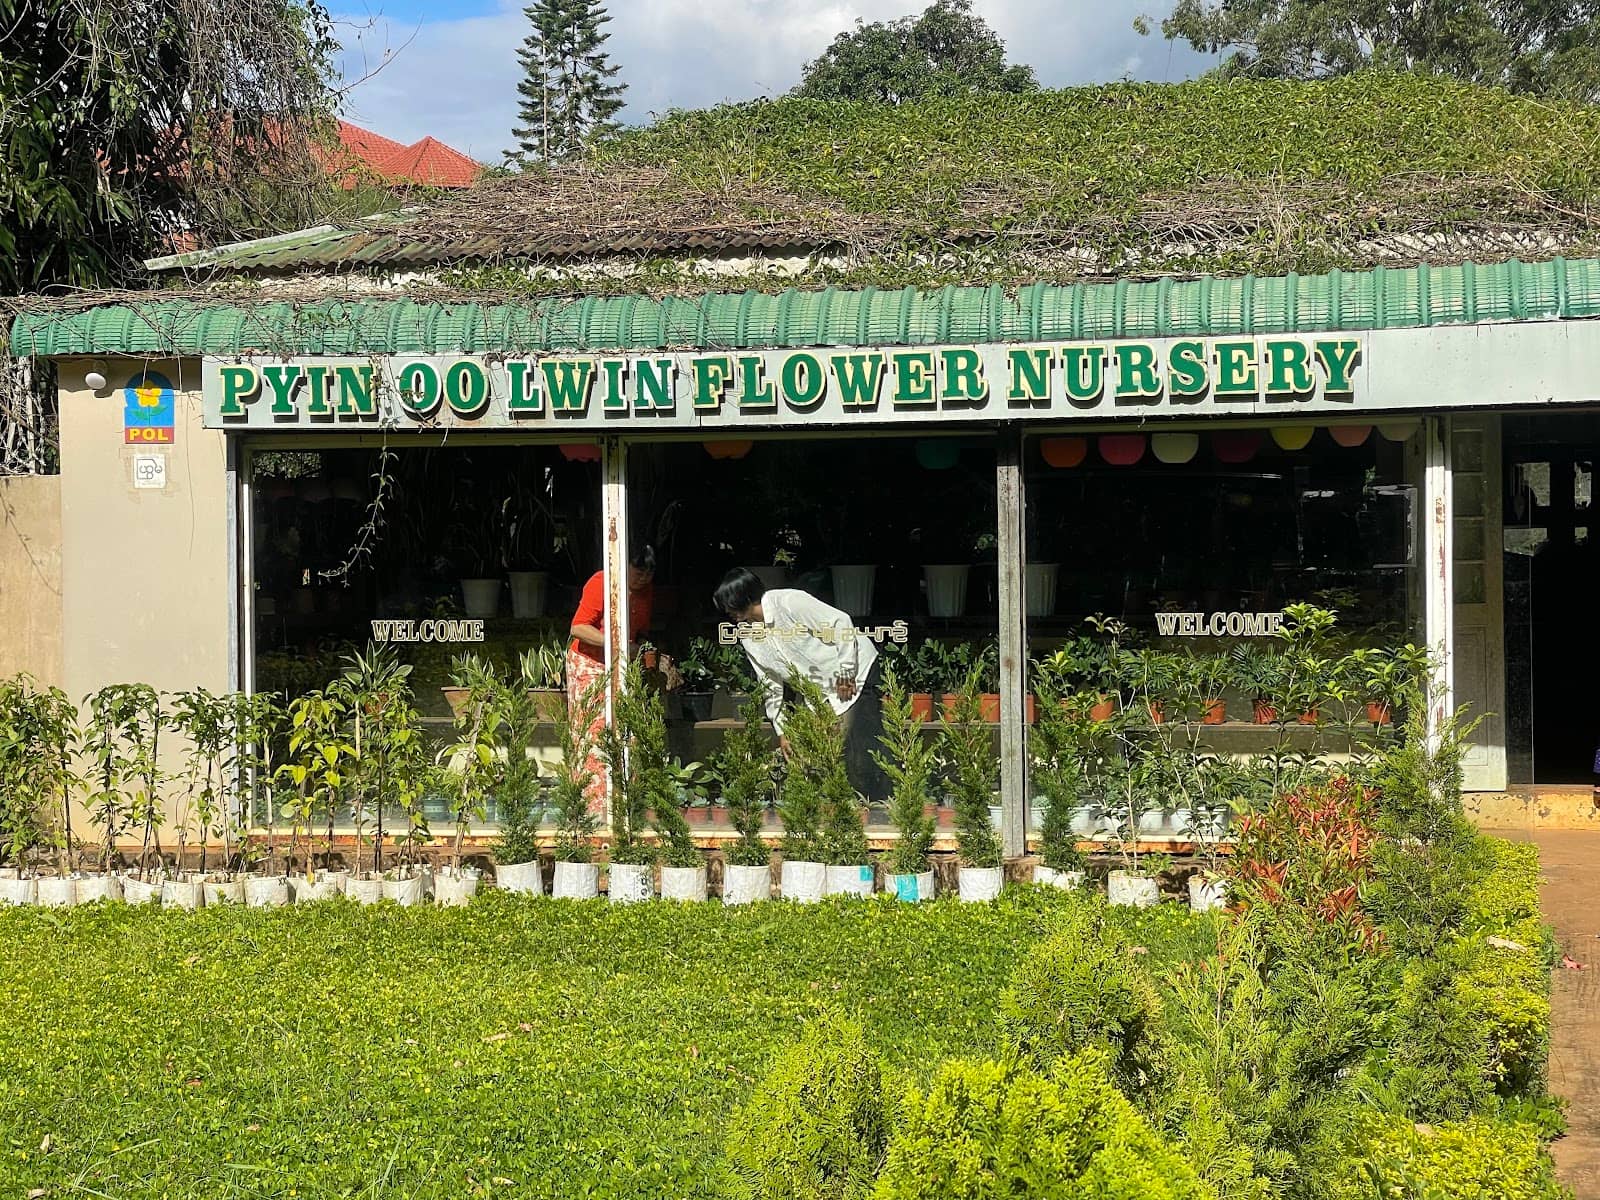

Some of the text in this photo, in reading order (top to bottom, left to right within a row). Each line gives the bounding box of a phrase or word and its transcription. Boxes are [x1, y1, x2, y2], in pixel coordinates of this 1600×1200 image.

[219, 338, 1362, 418] PYIN OO LWIN FLOWER NURSERY
[129, 428, 169, 441] POL
[371, 619, 485, 643] WELCOME
[1154, 611, 1284, 637] WELCOME
